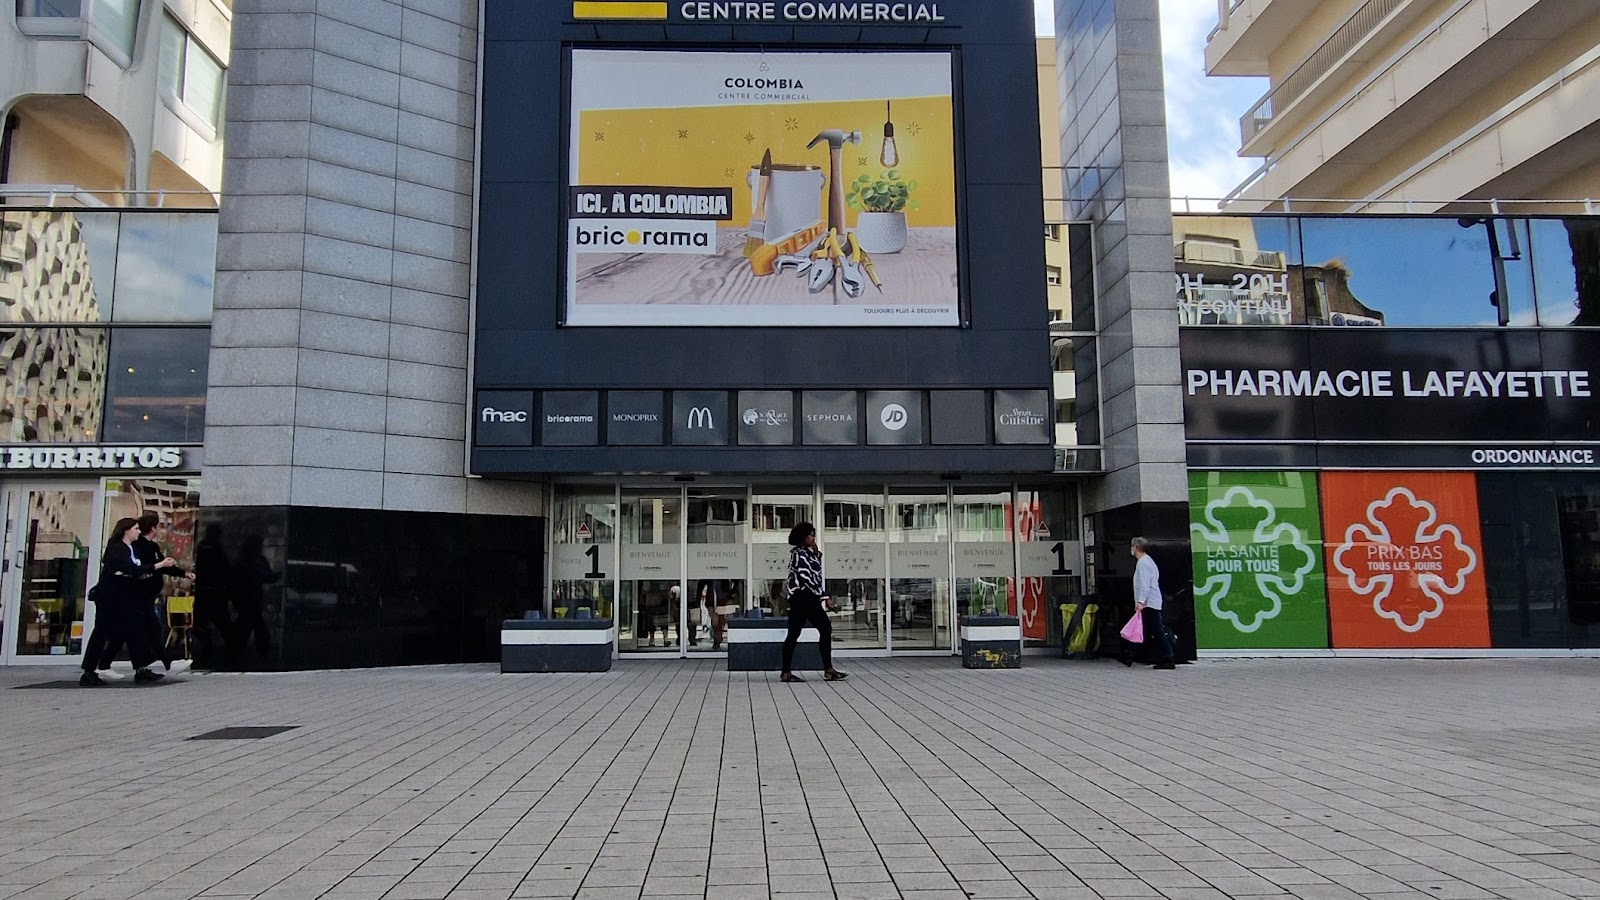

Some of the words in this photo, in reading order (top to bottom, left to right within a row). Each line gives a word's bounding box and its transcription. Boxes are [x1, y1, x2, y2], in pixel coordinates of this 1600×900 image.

[680, 2, 775, 21] CENTRE
[783, 2, 946, 22] COMMERCIAL
[724, 77, 804, 89] COLOMBIA
[576, 193, 608, 214] ICI,
[611, 191, 626, 214] À
[629, 193, 728, 215] COLOMBIA
[576, 225, 708, 247] bricorama
[1232, 273, 1289, 296] 20H
[910, 306, 918, 314] À
[916, 306, 950, 314] DÉCOUVRIR
[1186, 369, 1394, 397] PHARMACIE
[1402, 370, 1592, 398] LAFAYETTE
[481, 407, 527, 423] fnac
[547, 414, 593, 423] bricorama
[613, 413, 658, 422] MONOPRIX
[806, 413, 853, 422] SEPHORA
[885, 410, 904, 423] JD
[999, 413, 1045, 426] Cuisine
[6, 446, 183, 469] BURRITOS
[1471, 449, 1594, 464] ORDONNANCE
[629, 551, 671, 559] BIENVENUE
[1206, 545, 1227, 558] LA
[1229, 542, 1279, 558] SANTÉ
[1367, 545, 1405, 560] PRIX
[1409, 545, 1443, 560] BAS
[584, 544, 606, 579] 1
[1050, 541, 1073, 576] 1
[1206, 559, 1243, 573] POUR
[1244, 559, 1280, 573] TOUS
[1366, 561, 1391, 571] TOUS
[1393, 561, 1410, 571] LES
[1412, 561, 1443, 571] JOURS
